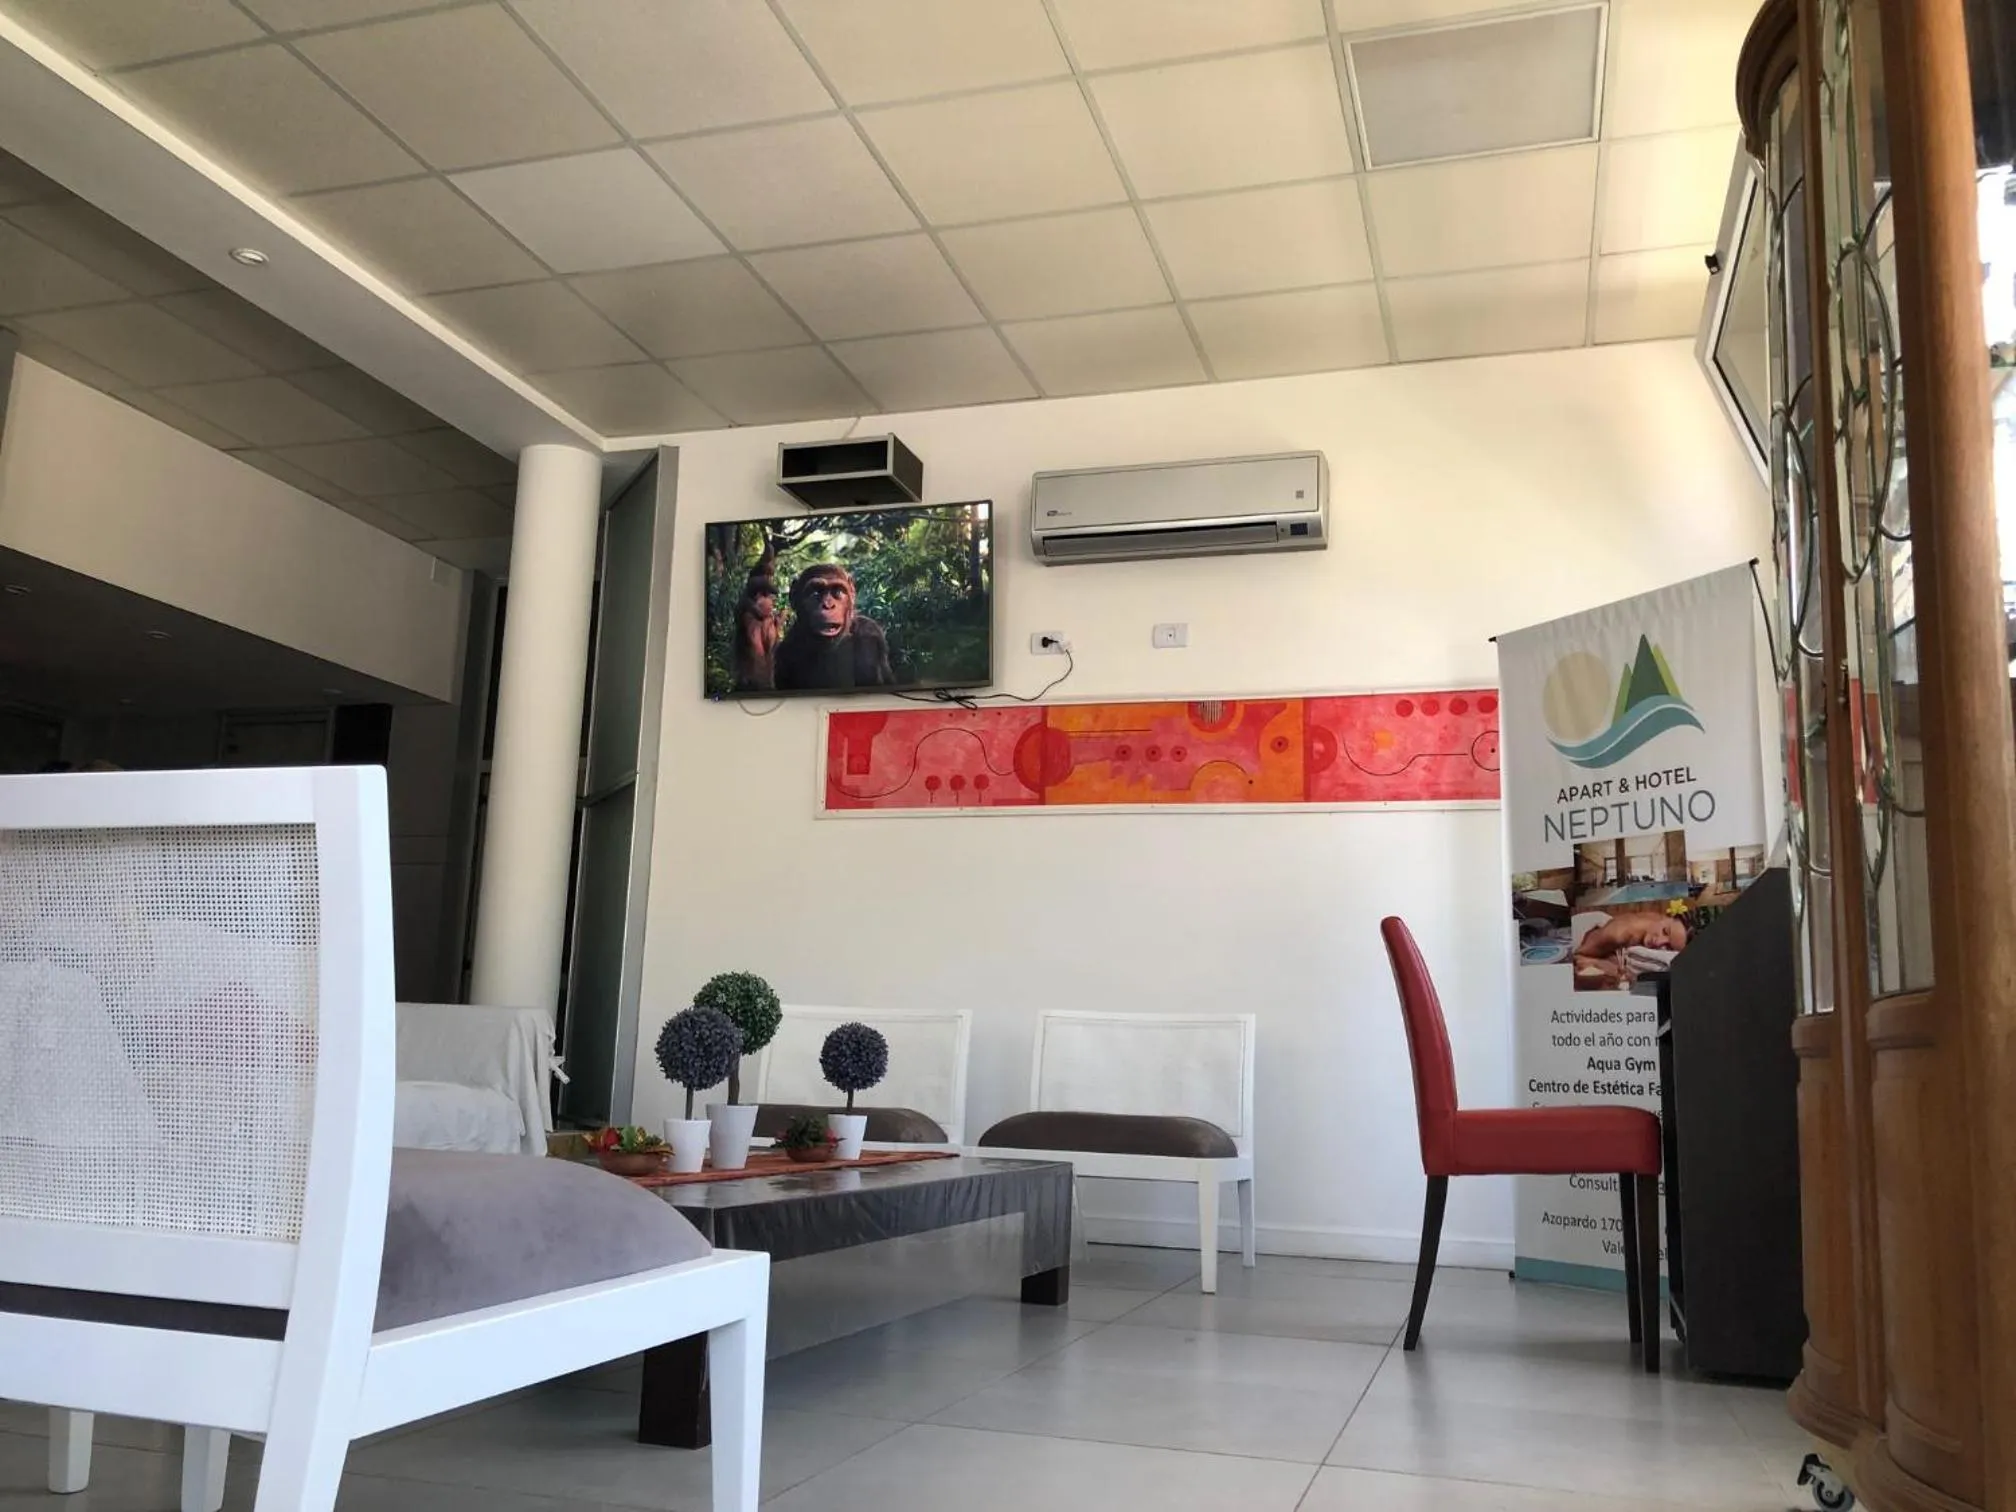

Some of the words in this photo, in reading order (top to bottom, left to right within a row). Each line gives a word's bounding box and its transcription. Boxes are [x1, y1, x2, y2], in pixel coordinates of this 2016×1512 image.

[1556, 779, 1613, 804] APART
[1618, 777, 1630, 793] &
[1634, 766, 1697, 791] HOTEL
[1544, 789, 1716, 843] NEPTUNO
[1551, 1008, 1623, 1024] Actividades
[1626, 1010, 1656, 1025] para
[1552, 1032, 1581, 1047] todo
[1584, 1032, 1595, 1047] el
[1599, 1032, 1623, 1047] año
[1627, 1035, 1650, 1047] con
[1587, 1056, 1621, 1075] Aqua
[1625, 1057, 1657, 1074] Gym
[1529, 1078, 1570, 1093] Centro
[1573, 1079, 1589, 1094] de
[1593, 1080, 1644, 1096] Estética
[1542, 1211, 1597, 1231] Azopardo
